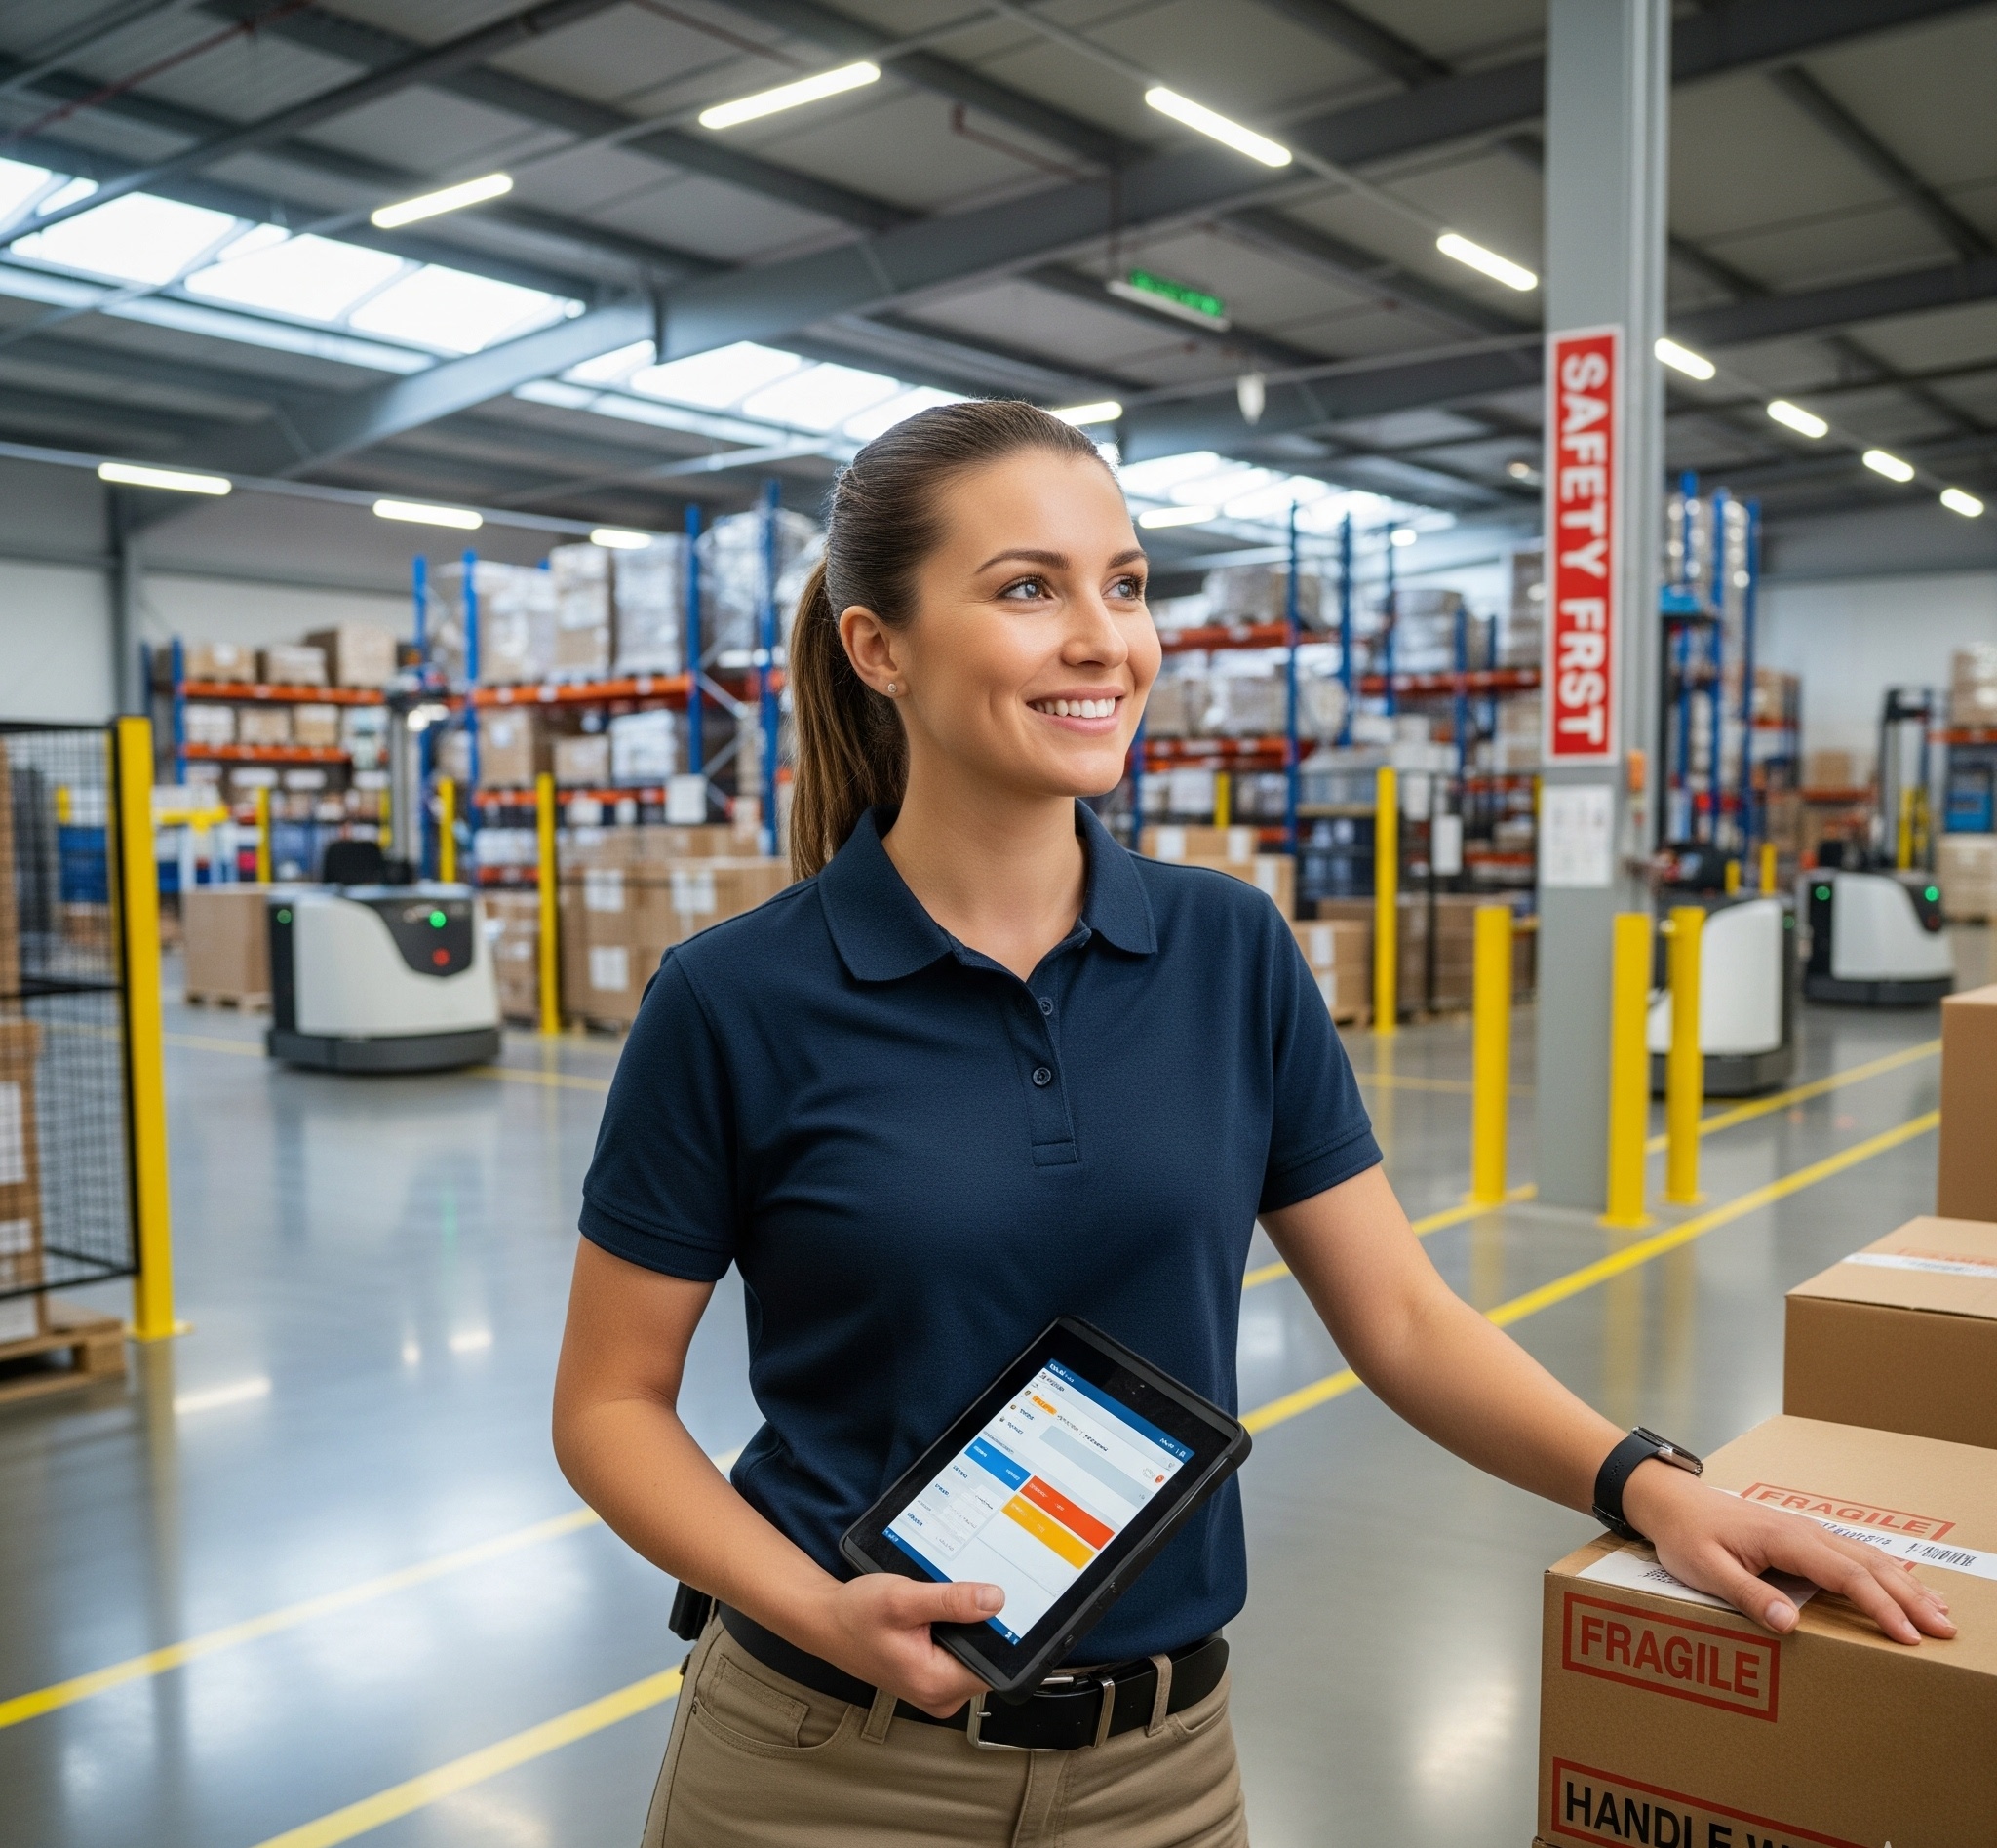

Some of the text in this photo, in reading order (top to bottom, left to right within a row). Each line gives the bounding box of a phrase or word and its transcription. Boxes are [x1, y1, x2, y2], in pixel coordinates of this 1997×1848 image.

[1558, 352, 1609, 746] SAFETY FRST
[1756, 1490, 1932, 1534] FRAGILE
[1581, 1614, 1760, 1699] FRAGILE
